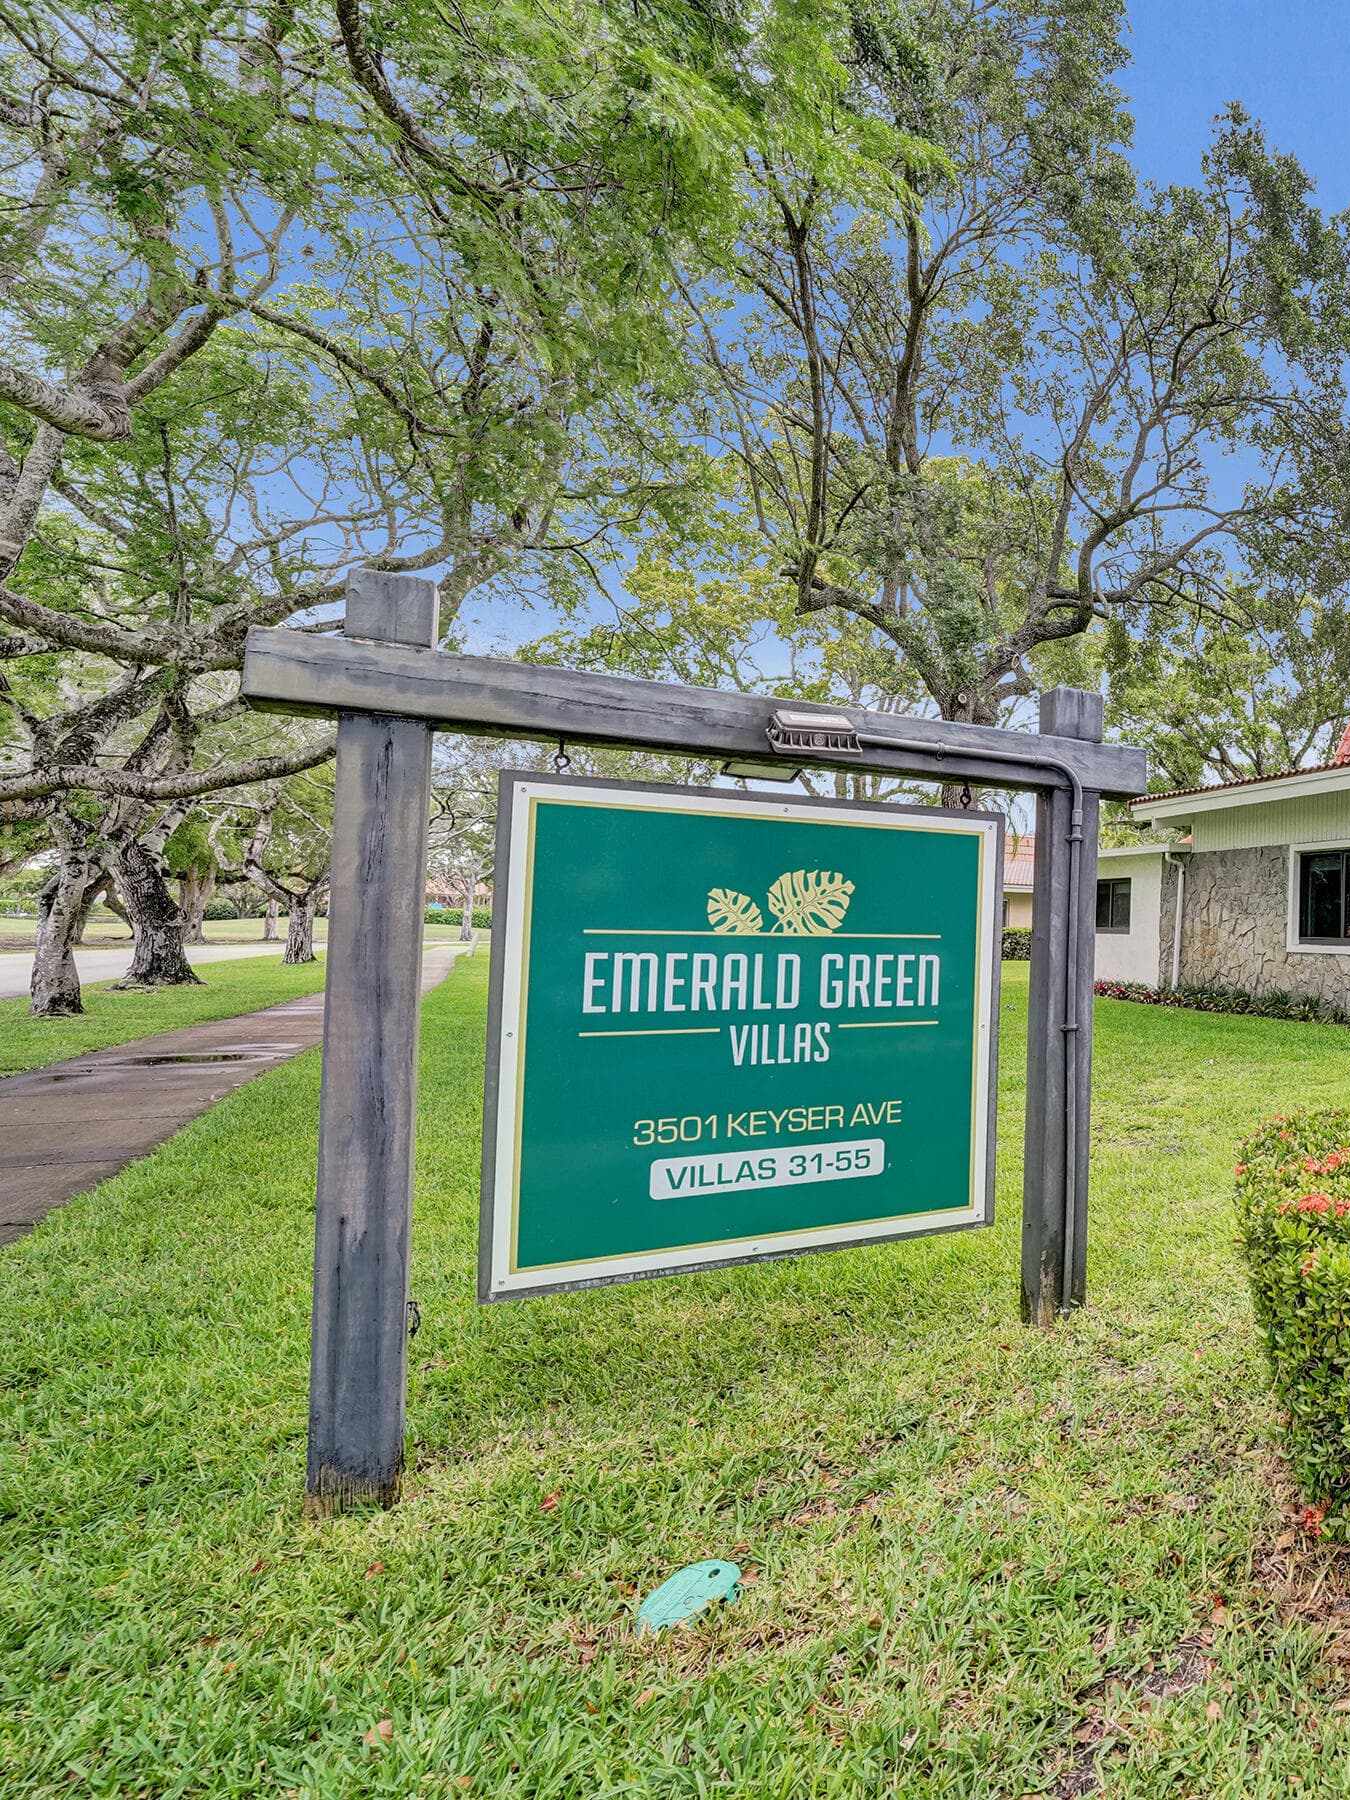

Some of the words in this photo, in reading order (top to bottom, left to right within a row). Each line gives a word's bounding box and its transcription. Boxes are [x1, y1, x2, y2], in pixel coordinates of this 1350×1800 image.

[582, 952, 801, 1013] EMERALD
[819, 953, 940, 1008] GREEN
[729, 1022, 831, 1065] VILLAS
[633, 1114, 717, 1146] 3501
[727, 1105, 845, 1138] KEYSER
[849, 1100, 902, 1127] AVE
[665, 1157, 776, 1190] VILLAS
[788, 1148, 871, 1176] 31-55
